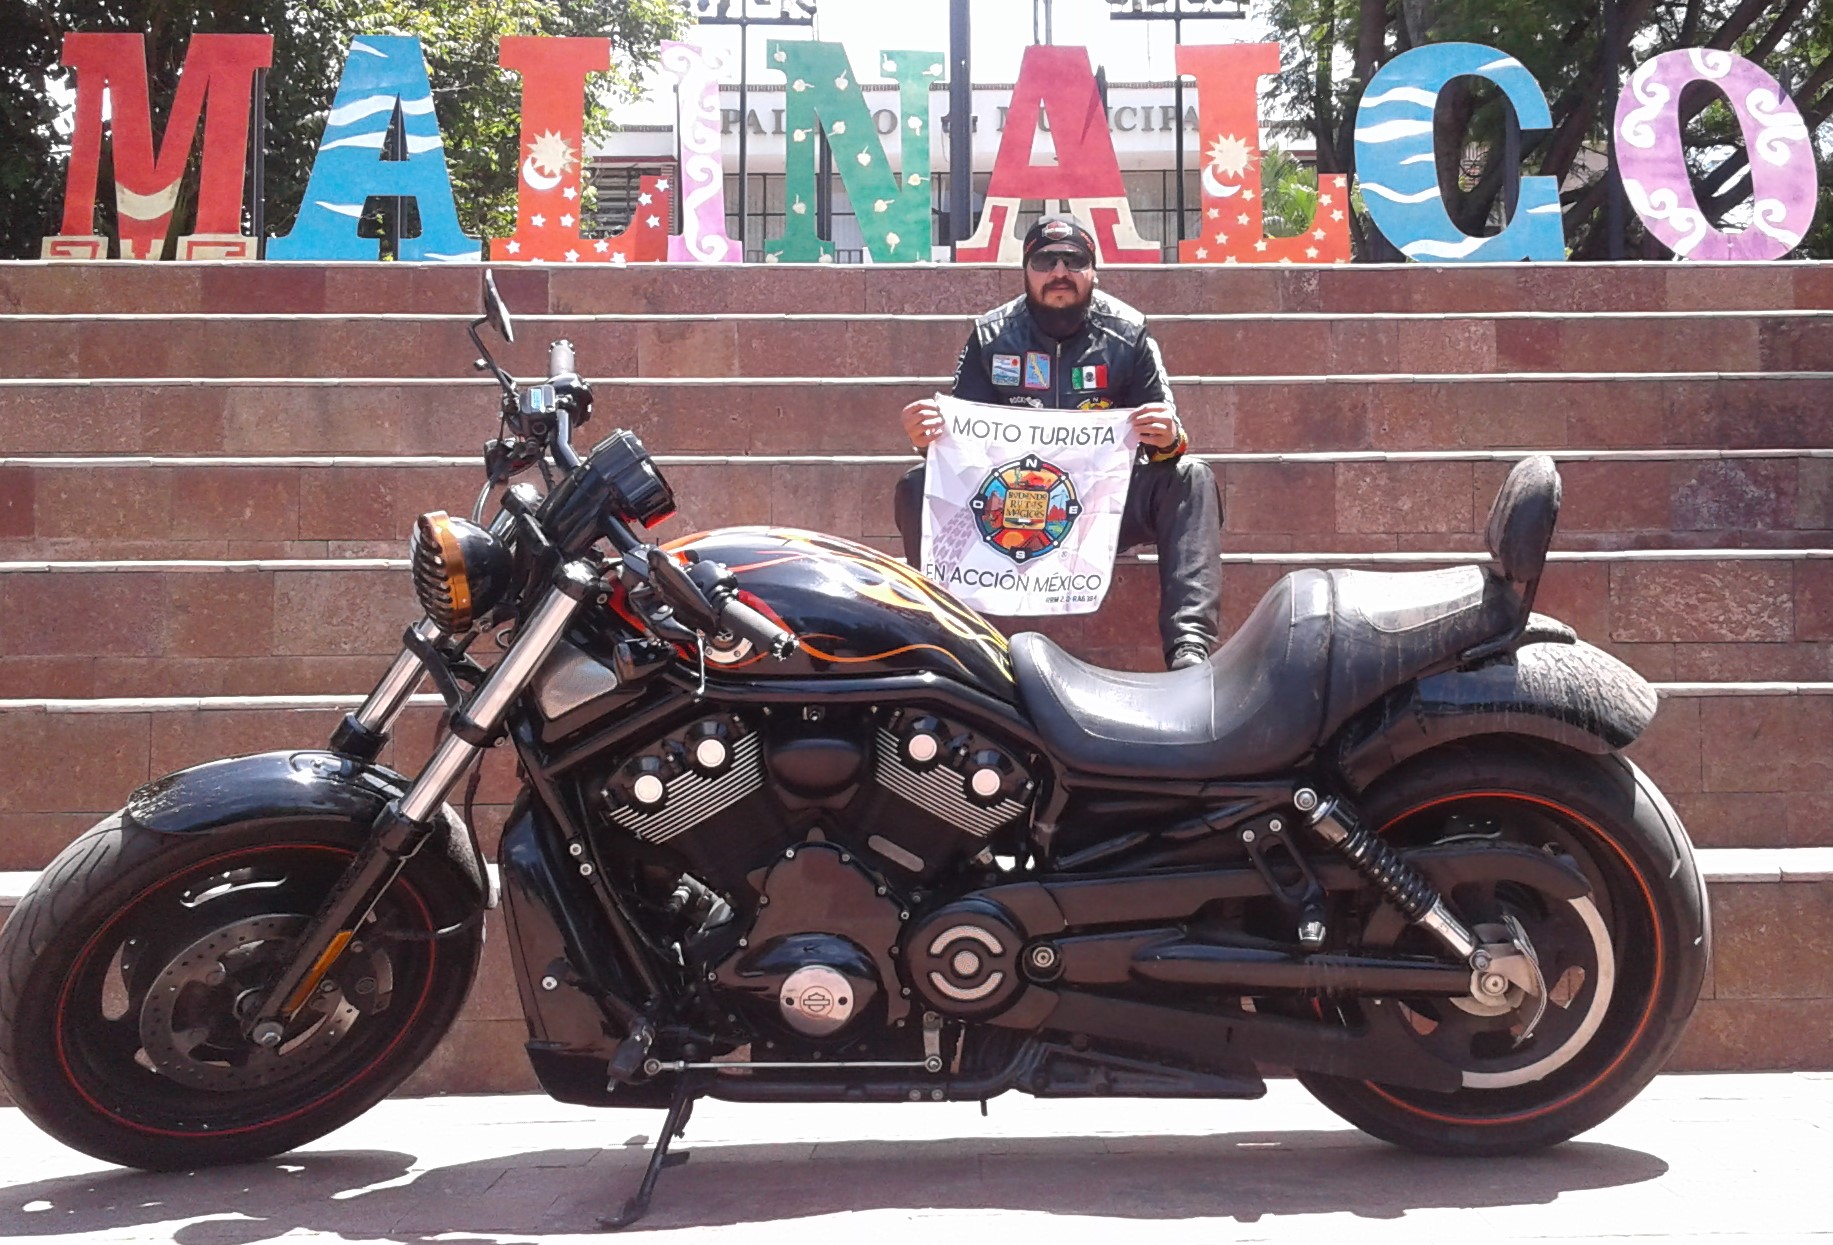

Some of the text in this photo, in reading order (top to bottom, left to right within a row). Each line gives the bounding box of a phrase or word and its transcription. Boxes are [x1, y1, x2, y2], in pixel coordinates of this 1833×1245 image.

[40, 33, 1819, 264] MALINALCO
[953, 416, 1115, 445] MOTO TURISTA
[1025, 457, 1038, 469] N
[1069, 505, 1078, 515] E
[1016, 550, 1026, 559] S
[926, 563, 1102, 593] EN ACCIÓN MÉXICO
